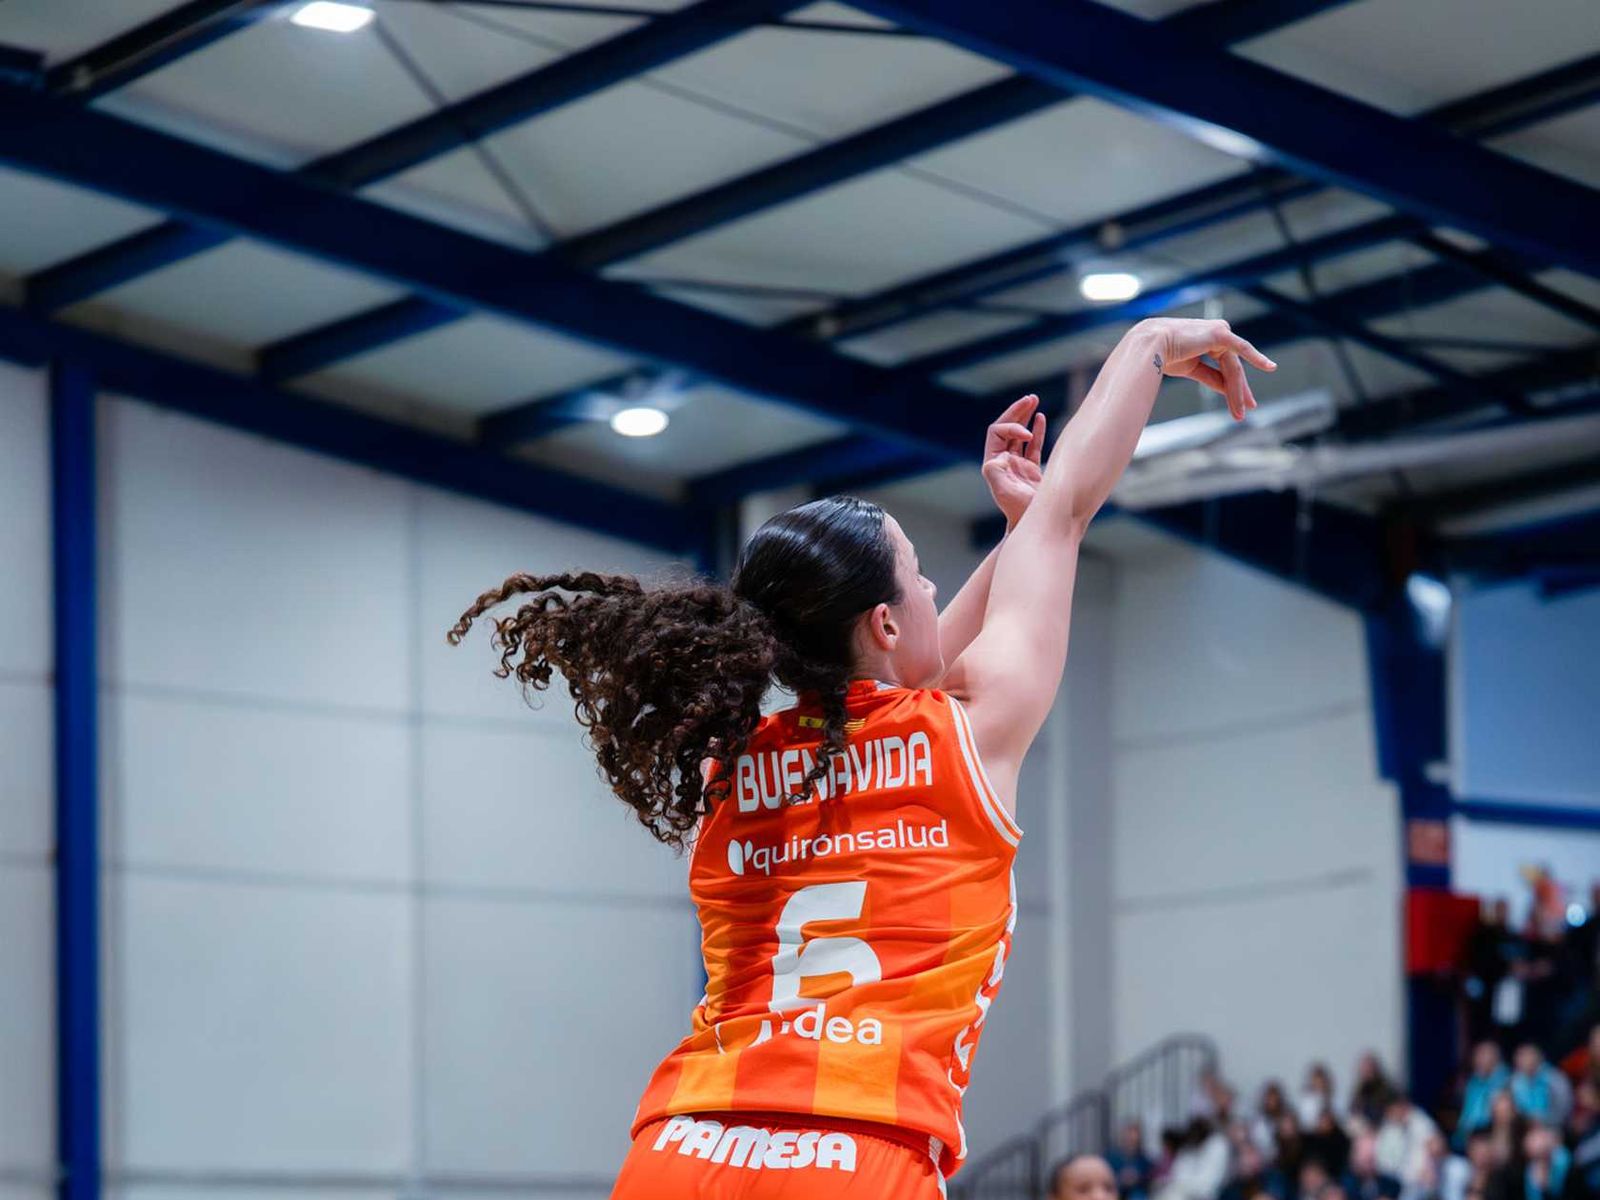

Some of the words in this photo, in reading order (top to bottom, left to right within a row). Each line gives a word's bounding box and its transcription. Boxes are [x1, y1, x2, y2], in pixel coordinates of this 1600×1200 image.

[736, 731, 933, 812] BUENAVIDA
[767, 880, 882, 1013] 6
[652, 1115, 857, 1172] PAMESA
